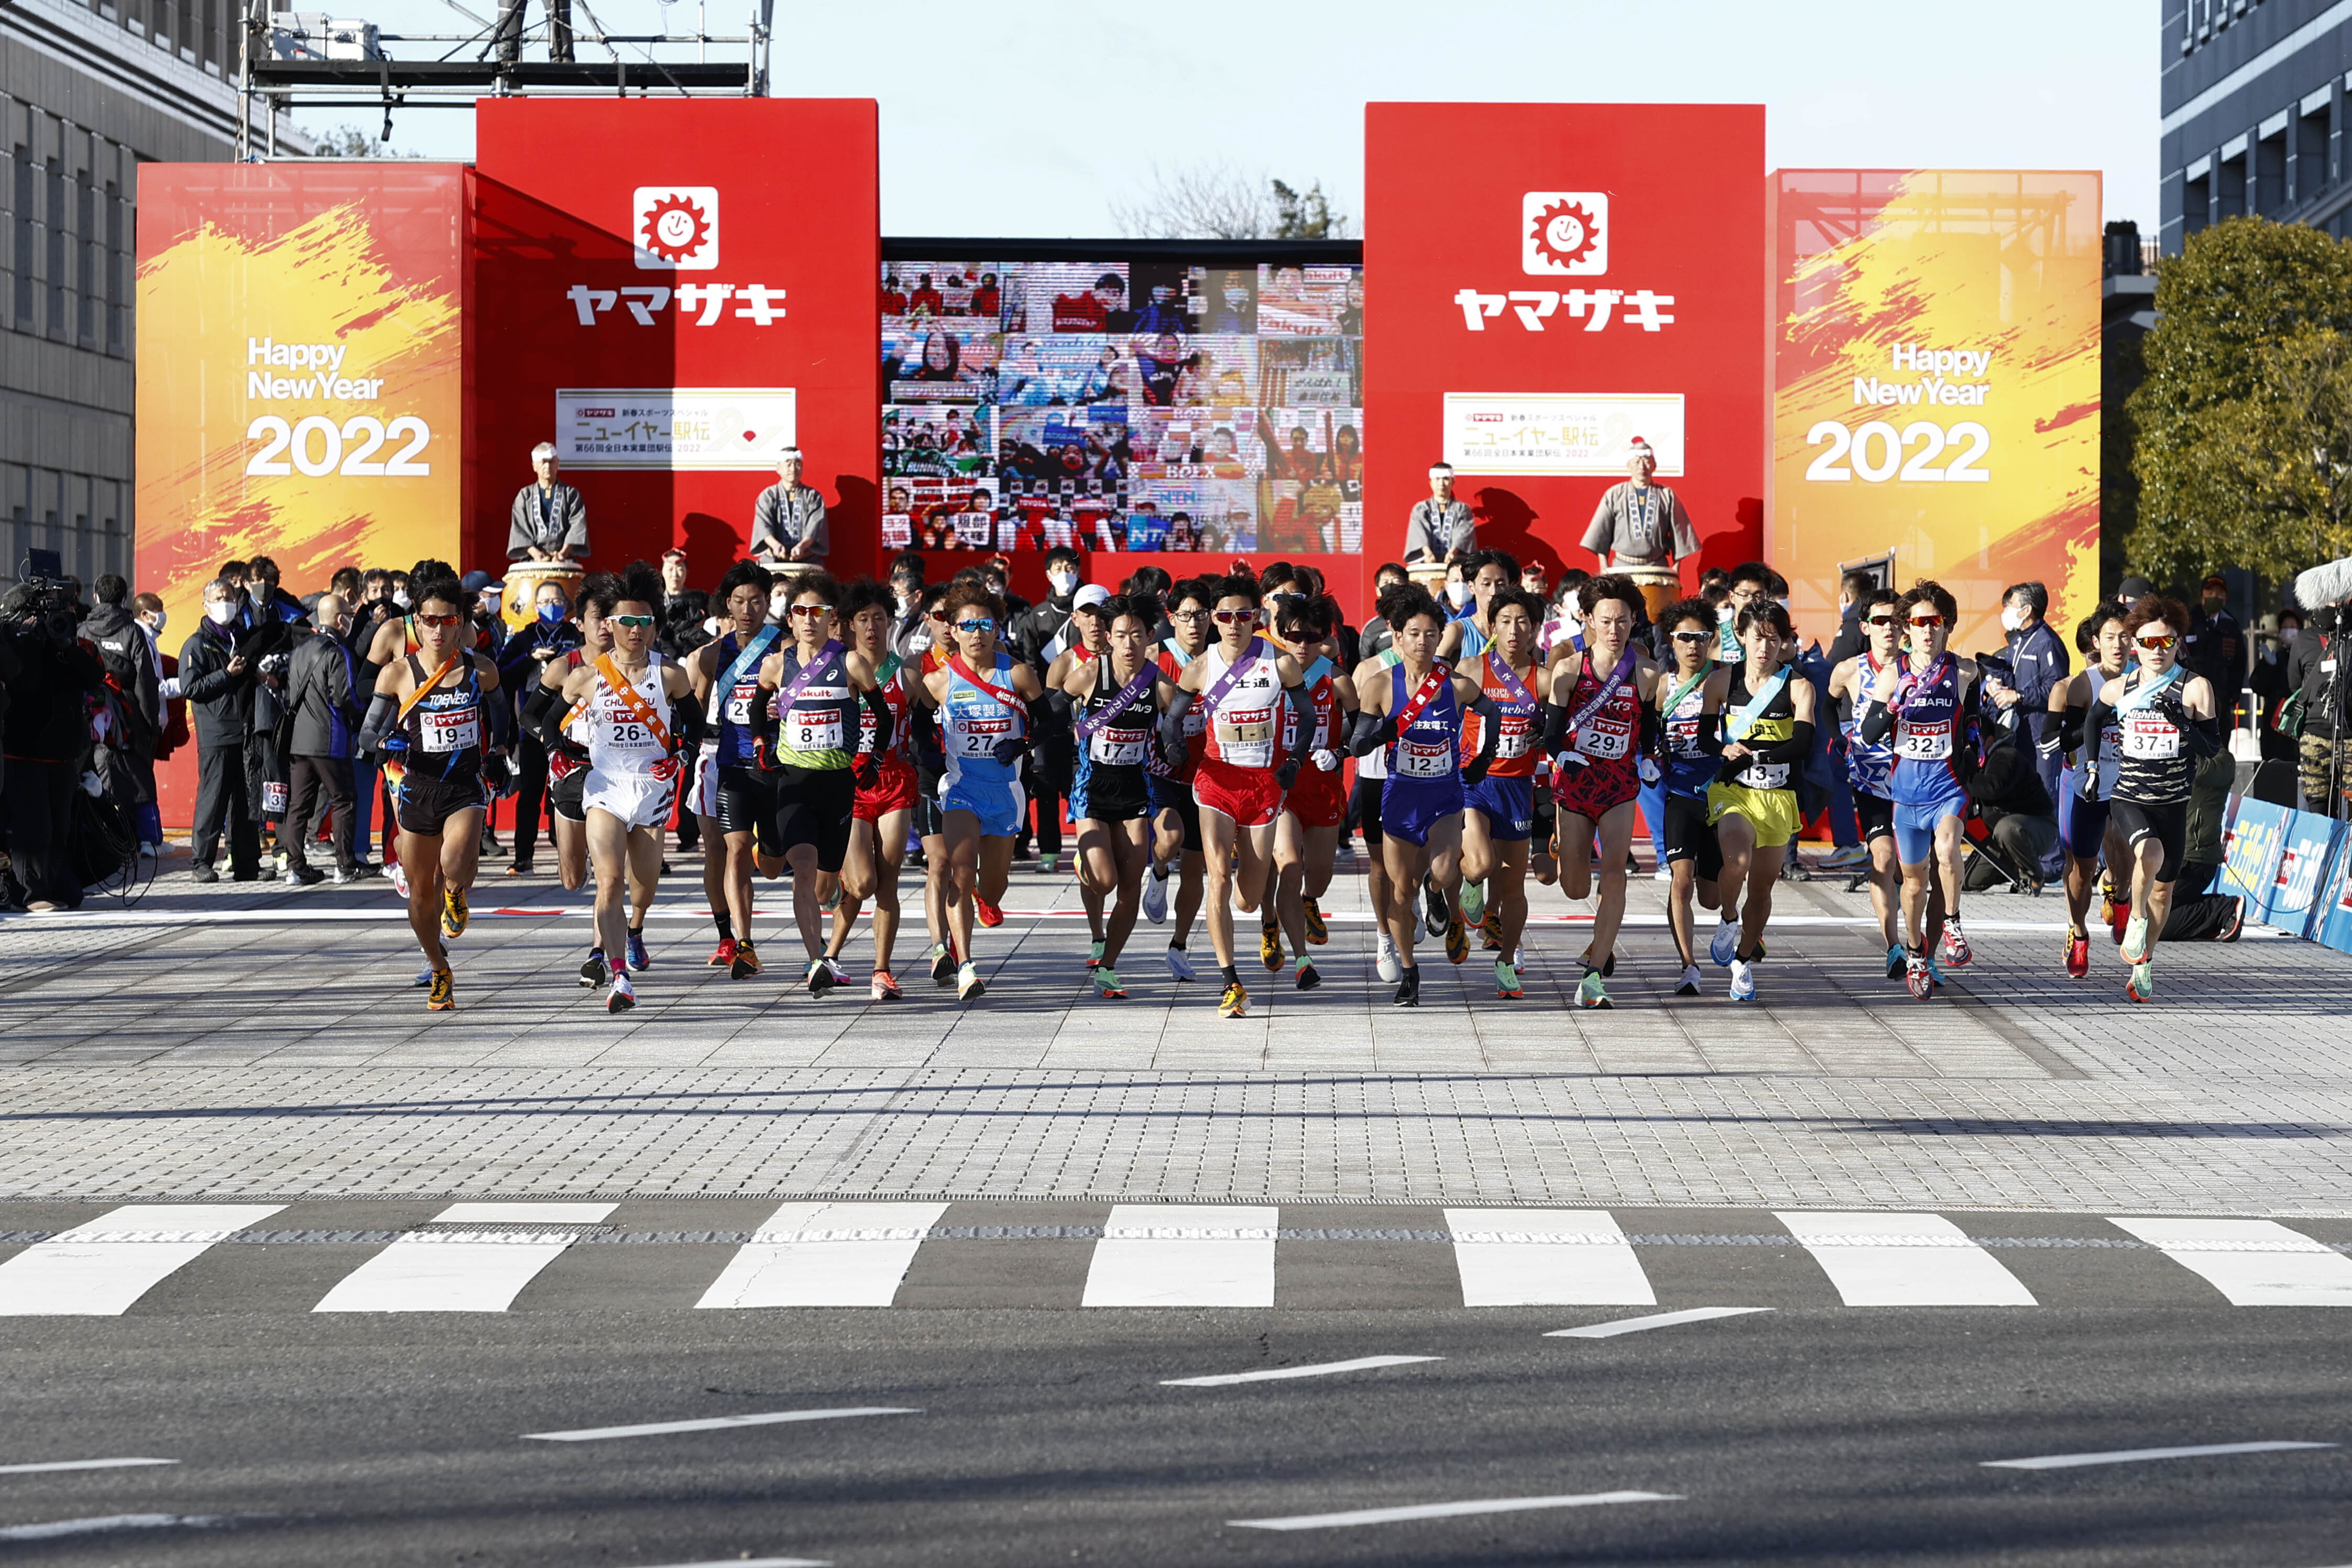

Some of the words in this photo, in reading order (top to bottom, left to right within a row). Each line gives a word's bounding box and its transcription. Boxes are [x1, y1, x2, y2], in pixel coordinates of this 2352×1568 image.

[566, 283, 786, 325] ヤマザキ
[1454, 289, 1675, 332] ヤマザキ
[248, 337, 346, 371] Happy
[1892, 343, 1990, 376] Happy
[575, 421, 710, 441] ニューイヤー駅伝
[1464, 426, 1599, 446] ニューイヤー駅伝
[246, 415, 430, 476] 2022
[575, 444, 672, 453] 第66回全日本実業団駅伝
[1805, 421, 1990, 483] 2022
[1236, 677, 1270, 688] 士通
[429, 690, 470, 708] TOENEC
[1403, 665, 1447, 721] 住友電工
[1085, 685, 1136, 730] コニカミノルタ
[1909, 698, 1953, 707] UBARU
[436, 712, 474, 725] ヤマザキ
[800, 713, 838, 723] ヤマザキ
[954, 704, 1010, 718] 大塚製薬
[1231, 711, 1270, 721] ヤマザキ
[970, 722, 1009, 731] ヤマザキ
[1413, 720, 1449, 730] 住友電工
[1596, 721, 1628, 733] ヤマザ
[1751, 724, 1776, 736] 電工
[1912, 725, 1947, 733] ヤマザキ
[2136, 723, 2175, 731] ヤマザキ
[434, 727, 473, 744] 19-1
[801, 728, 836, 742] 8-1
[1109, 732, 1144, 740] ヤマザキ
[1235, 726, 1267, 741] 1-1
[1413, 743, 1448, 754] ヤマザキ
[1588, 733, 1625, 751] 29-1
[1908, 738, 1945, 753] 32-1
[2135, 736, 2172, 751] 37-1
[1103, 743, 1139, 758] 17-1
[1408, 756, 1446, 771] 12-1
